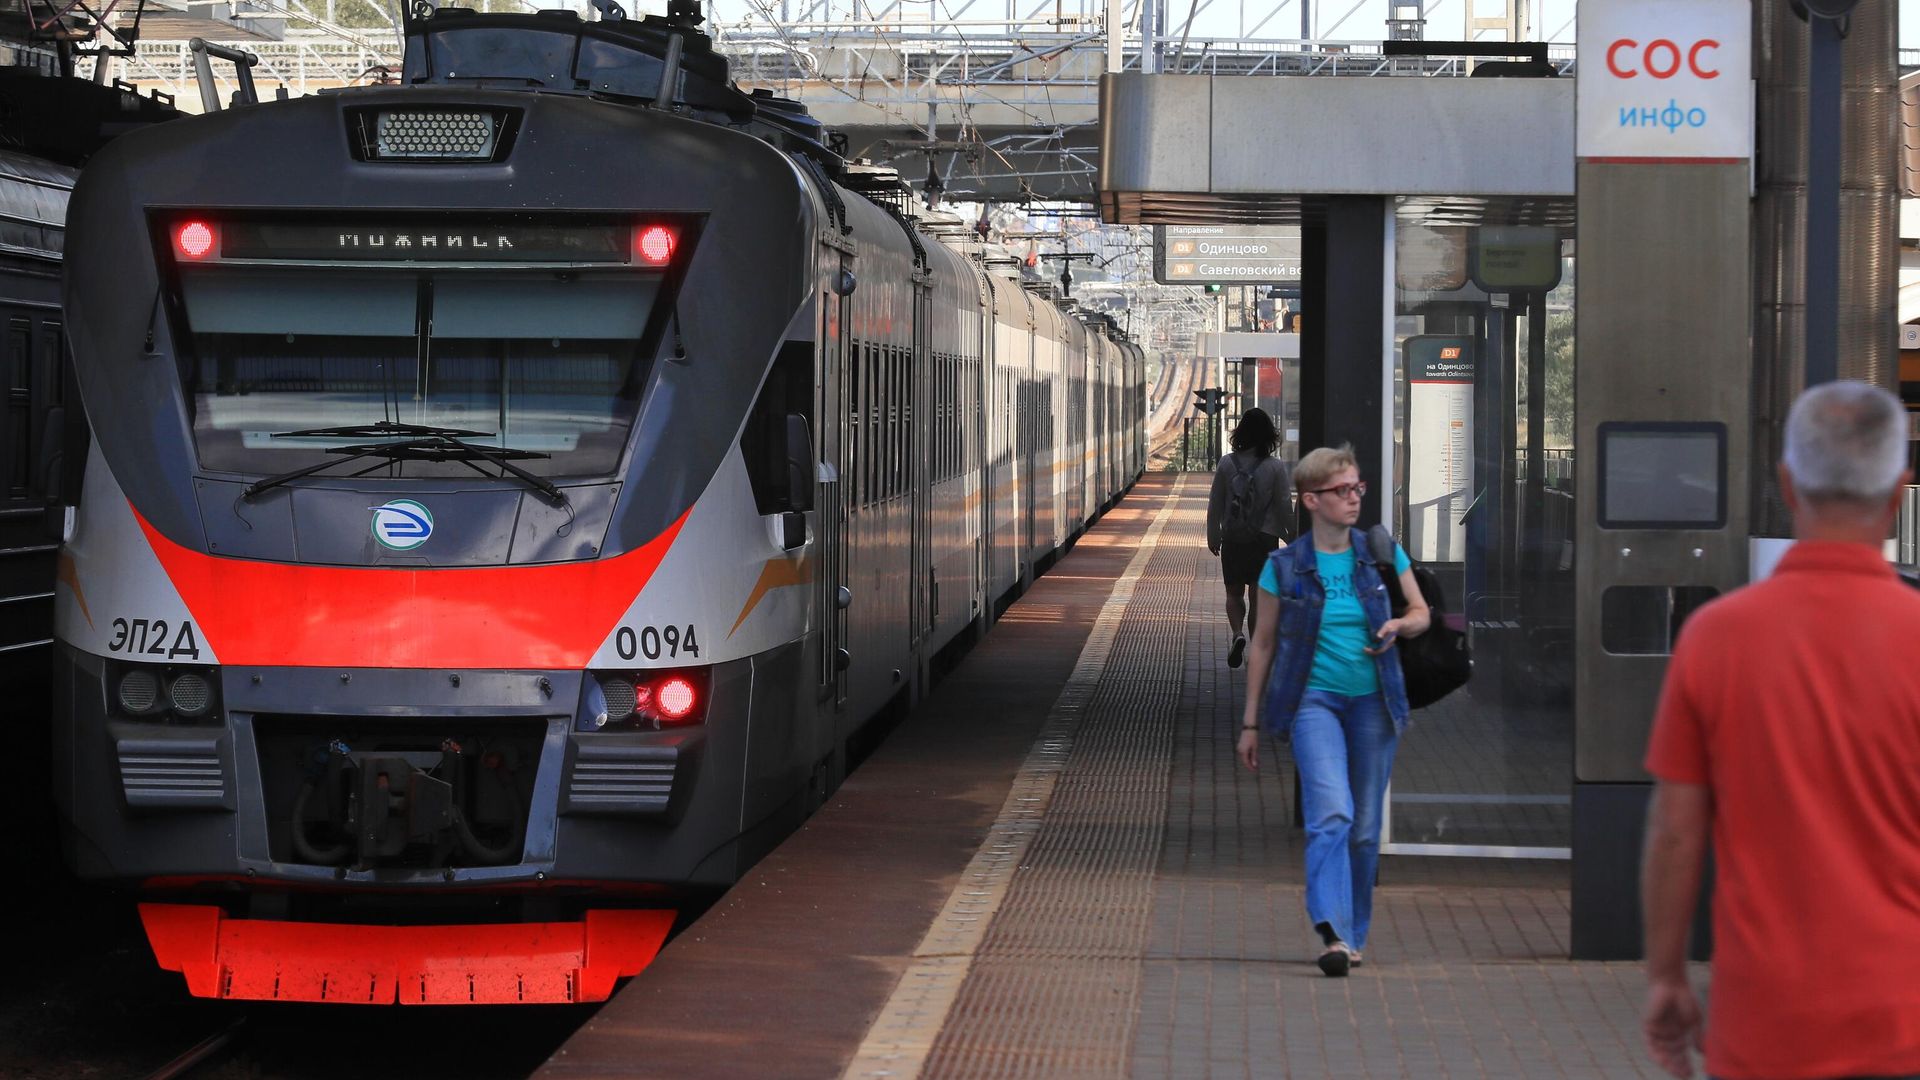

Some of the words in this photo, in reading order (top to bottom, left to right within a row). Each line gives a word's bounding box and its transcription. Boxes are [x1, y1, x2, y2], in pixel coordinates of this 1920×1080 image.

[1606, 39, 1720, 79] СОС
[1618, 99, 1707, 134] инфо
[1173, 226, 1224, 235] Направление
[1199, 242, 1268, 255] Одинцово
[1199, 263, 1286, 275] Савеловский
[1445, 349, 1456, 357] D1
[108, 617, 200, 660] ЭП2Д
[615, 624, 699, 660] 0094
